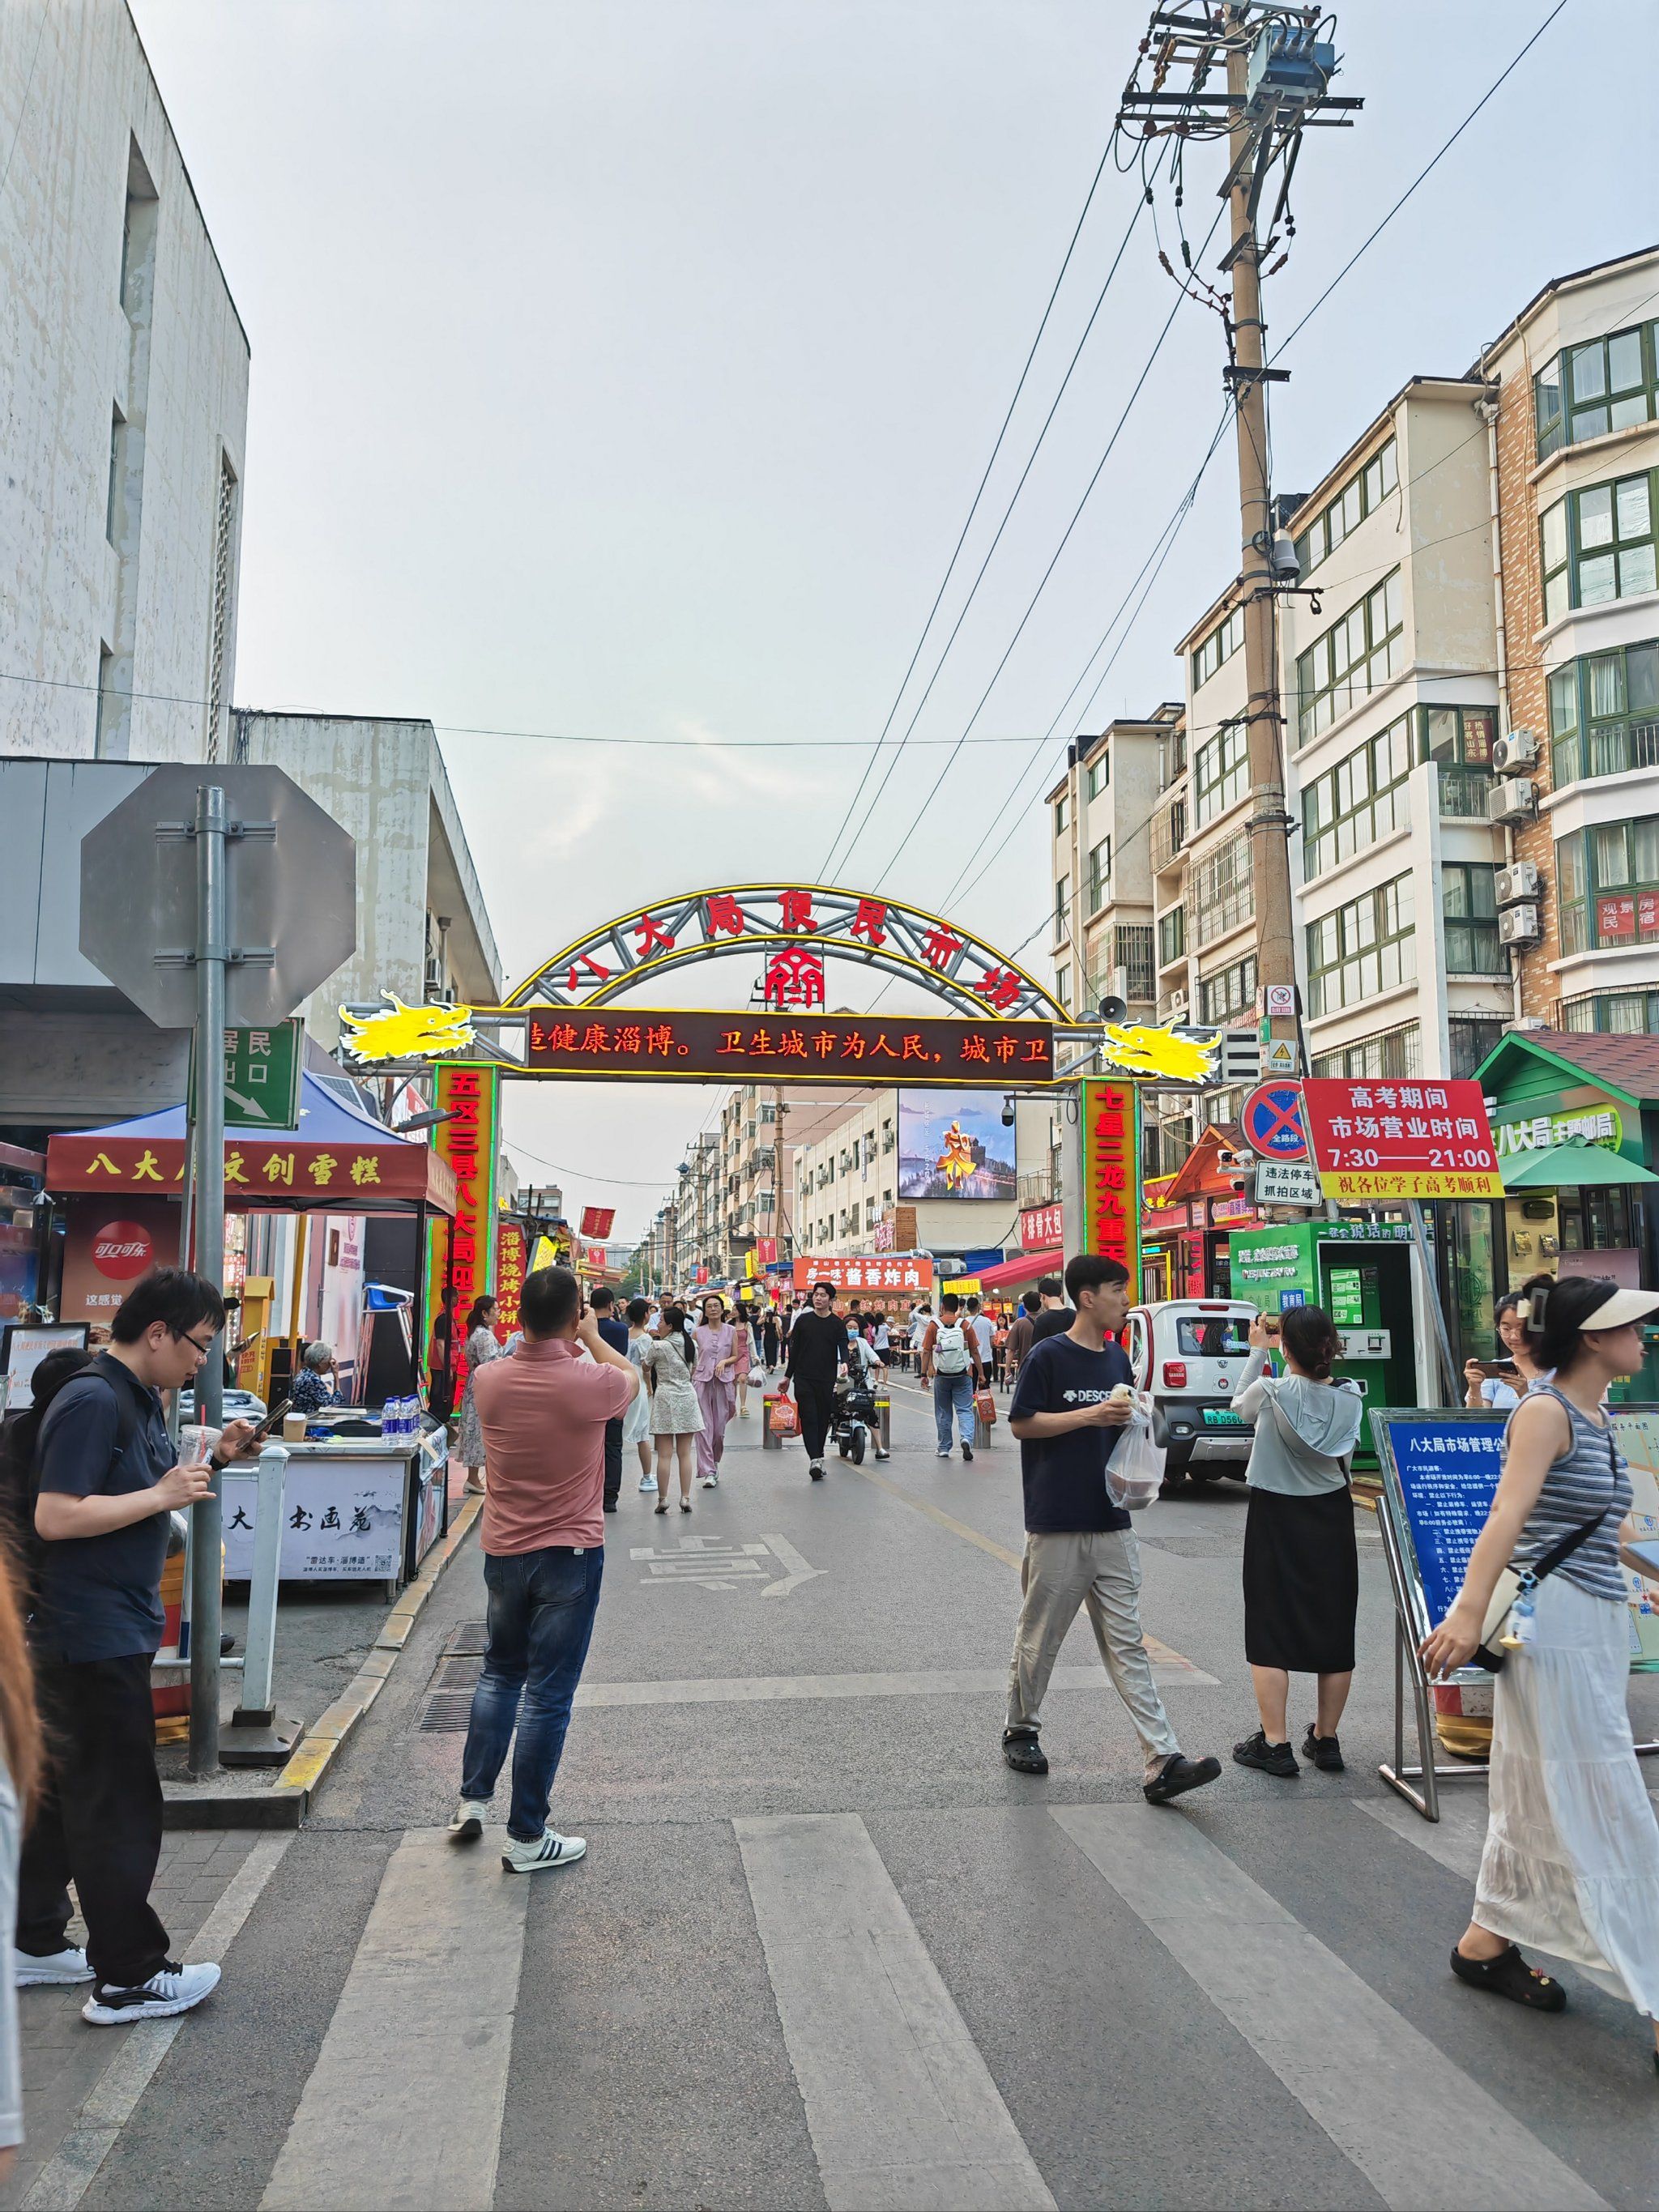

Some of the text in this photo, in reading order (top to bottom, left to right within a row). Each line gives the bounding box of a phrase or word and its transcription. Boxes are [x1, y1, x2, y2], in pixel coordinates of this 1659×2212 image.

[1602, 911, 1655, 930] 民宿
[567, 889, 1021, 1011] 八大局便民市场
[224, 1030, 271, 1056] 居民
[1348, 1086, 1448, 1110] 高考期间
[1328, 1116, 1478, 1140] 市场营业时间
[1492, 1112, 1616, 1157] 八大局主题邮局
[1272, 1134, 1299, 1143] 全路段
[1265, 1166, 1314, 1182] 违法停车
[1264, 1184, 1313, 1200] 抓拍区域
[1338, 1176, 1491, 1194] 祝各位学子高考顺利
[95, 1241, 151, 1258] 可口可乐
[846, 1267, 920, 1286] 酱香炸肉
[85, 1294, 123, 1307] 这感觉
[833, 1298, 923, 1311] 山统炸肉直
[1282, 1294, 1303, 1308] 教育局
